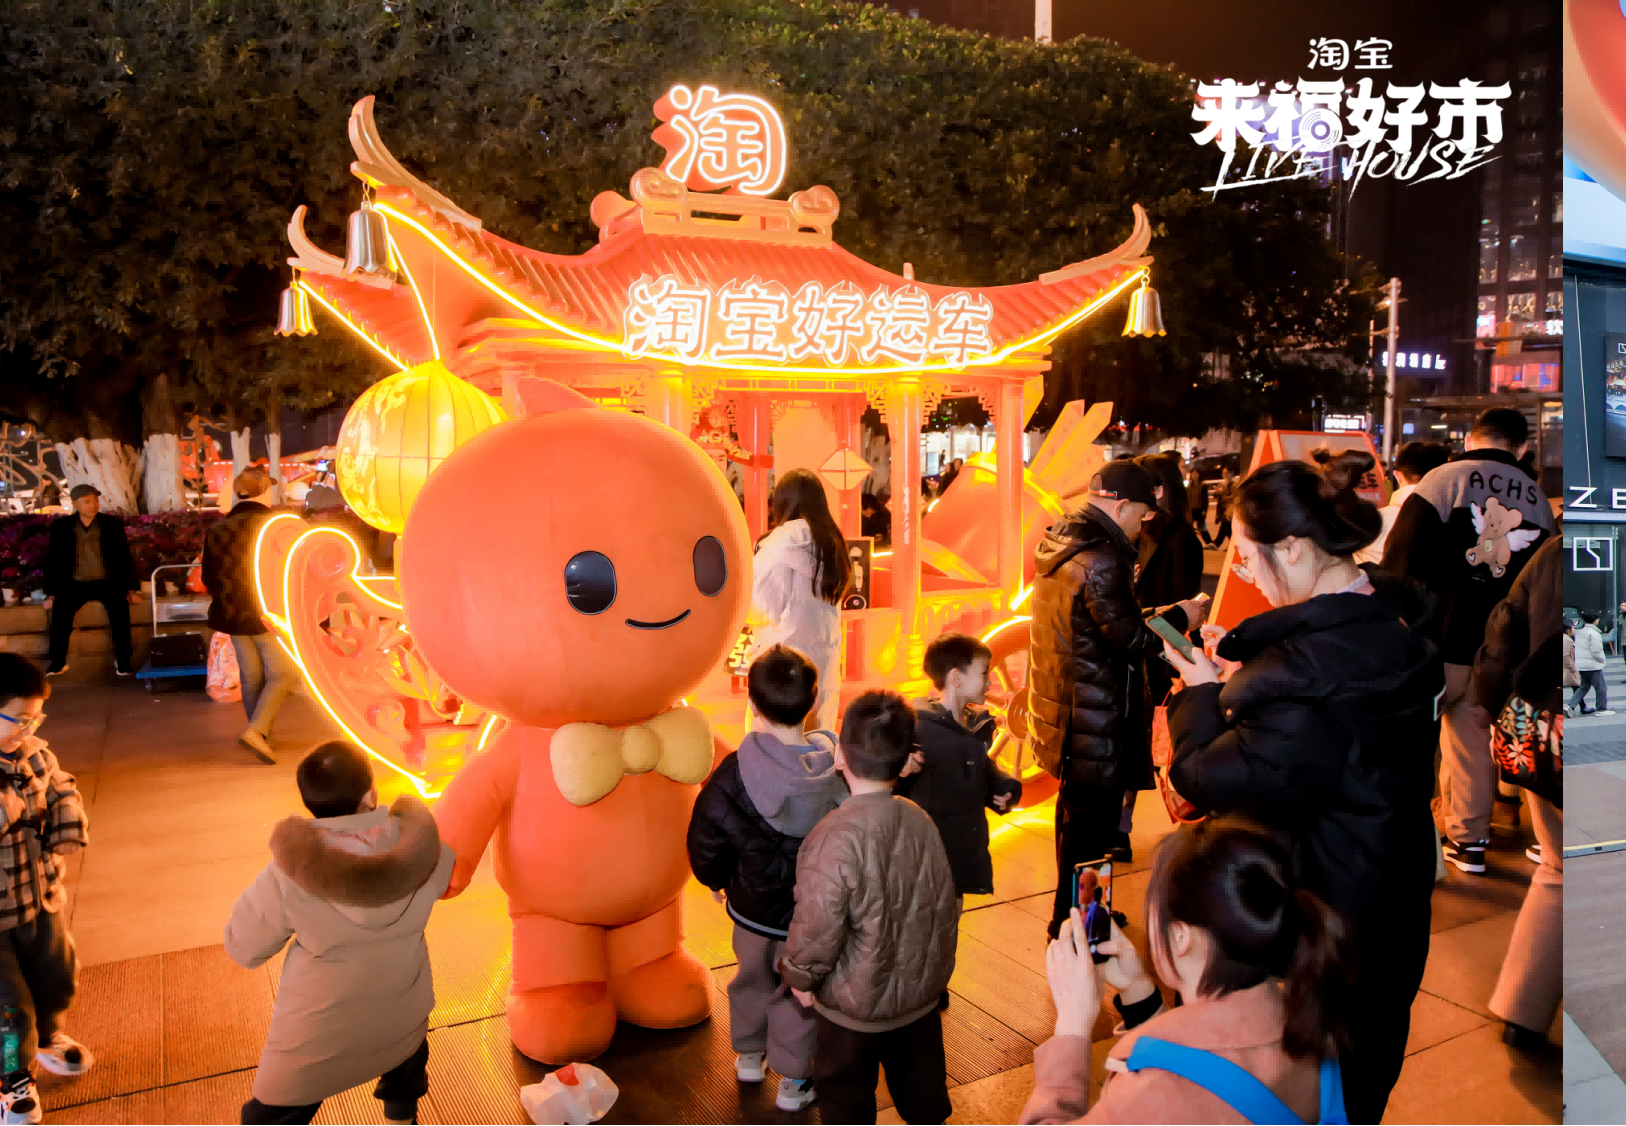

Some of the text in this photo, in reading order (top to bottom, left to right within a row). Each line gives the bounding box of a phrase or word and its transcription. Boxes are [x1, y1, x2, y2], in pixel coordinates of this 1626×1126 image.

[665, 84, 788, 196] 淘
[623, 274, 994, 369] 淘宝好运车
[1469, 470, 1538, 506] ACHS
